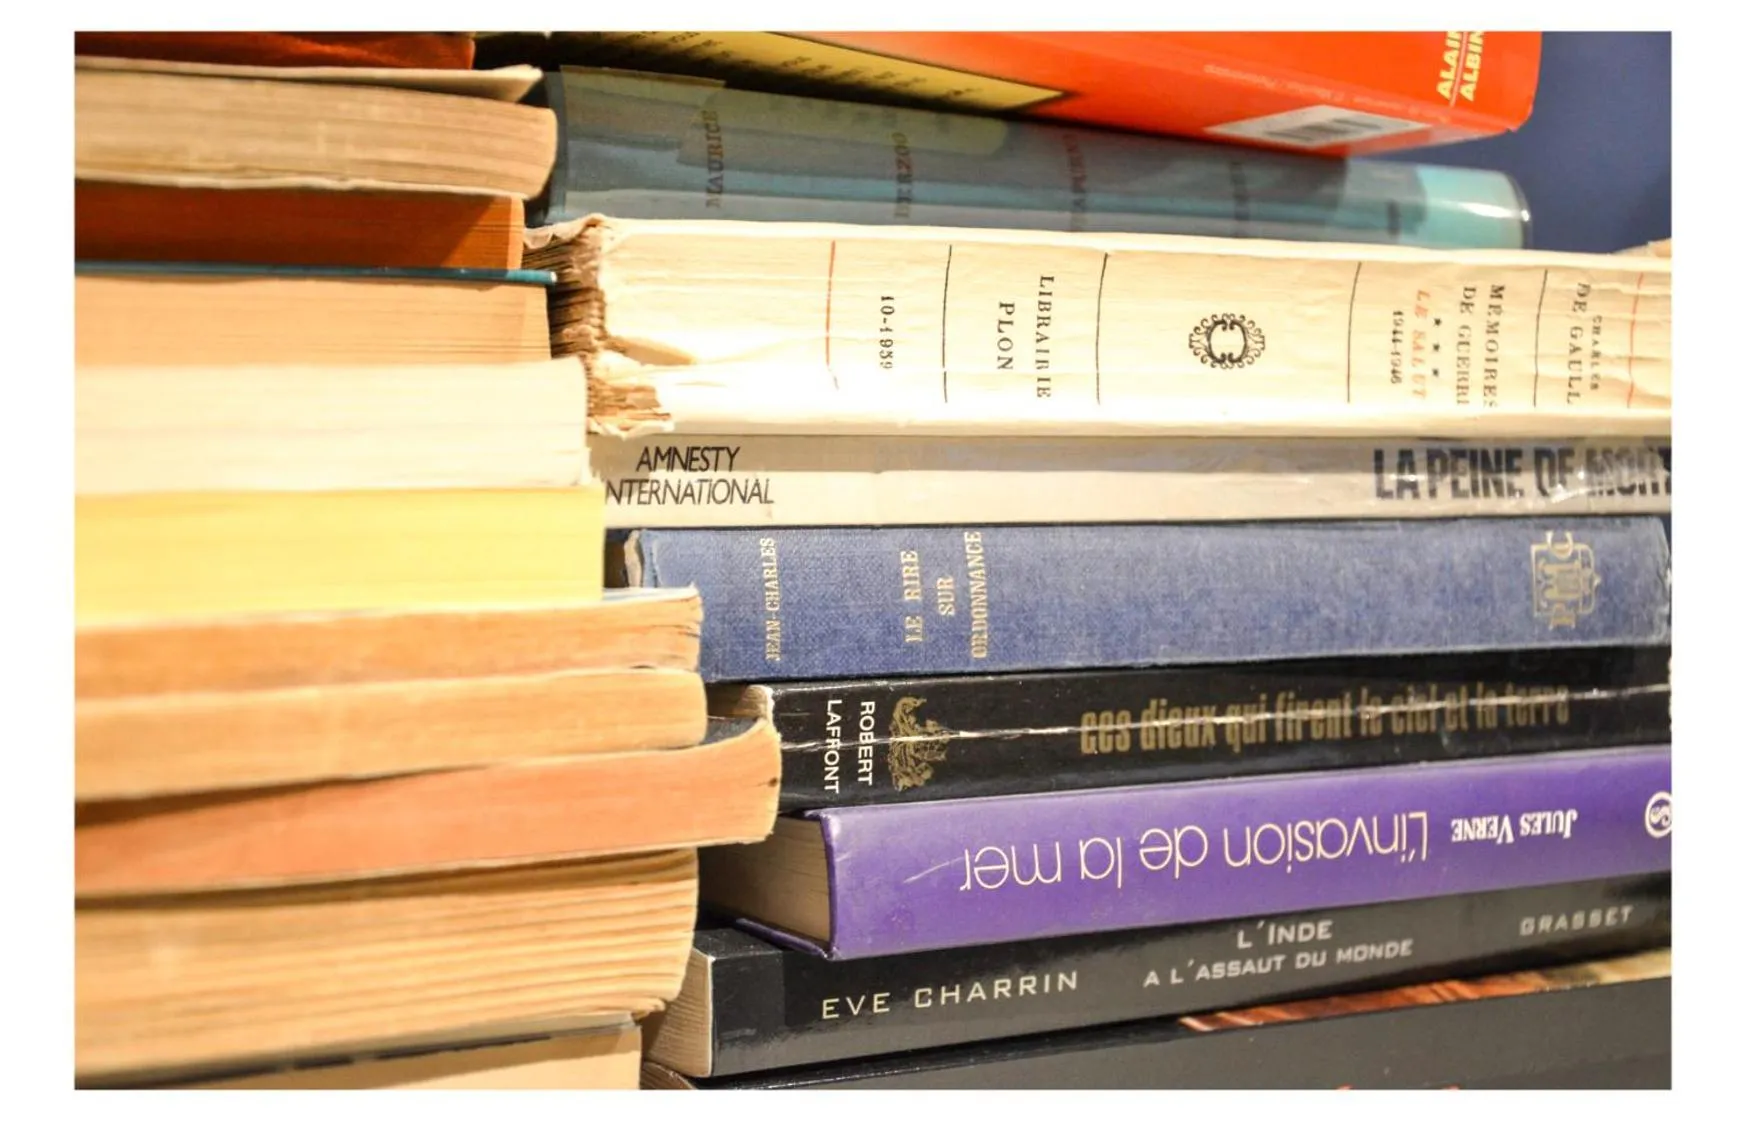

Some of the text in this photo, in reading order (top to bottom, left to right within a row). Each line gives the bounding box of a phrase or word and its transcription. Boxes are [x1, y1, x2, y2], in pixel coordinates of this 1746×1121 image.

[705, 110, 723, 207] MAURICE
[1460, 286, 1477, 314] DE
[996, 301, 1015, 370] PLON
[1035, 275, 1055, 398] LIBRAIRIE
[1411, 289, 1430, 399] LE SALUT
[1566, 282, 1591, 405] DE GAULL
[636, 445, 741, 473] AMNESTY
[1374, 448, 1420, 498] LA
[1426, 448, 1525, 498] PEINE
[604, 478, 774, 505] NTERNATIONAL
[900, 549, 924, 643] LE RIRE
[936, 575, 956, 617] SUR
[964, 530, 989, 660] ORDONNANCE
[857, 701, 876, 786] ROBERT
[1140, 698, 1216, 751] dieux
[1225, 693, 1268, 752] qui
[1275, 691, 1352, 741] firent
[1359, 686, 1383, 737] le
[1391, 682, 1438, 735] ciel
[1443, 685, 1468, 731] et
[1476, 681, 1498, 728] la
[1506, 680, 1570, 726] terre
[960, 811, 1428, 893] L'invasion de la mer
[1451, 809, 1578, 844] JULES VERNE
[1237, 920, 1333, 949] L'INDE
[1519, 905, 1633, 936] GRASSET
[1144, 939, 1413, 987] A L'ASSAUT DU MONDE
[822, 971, 1078, 1019] EVE CHARRIN
